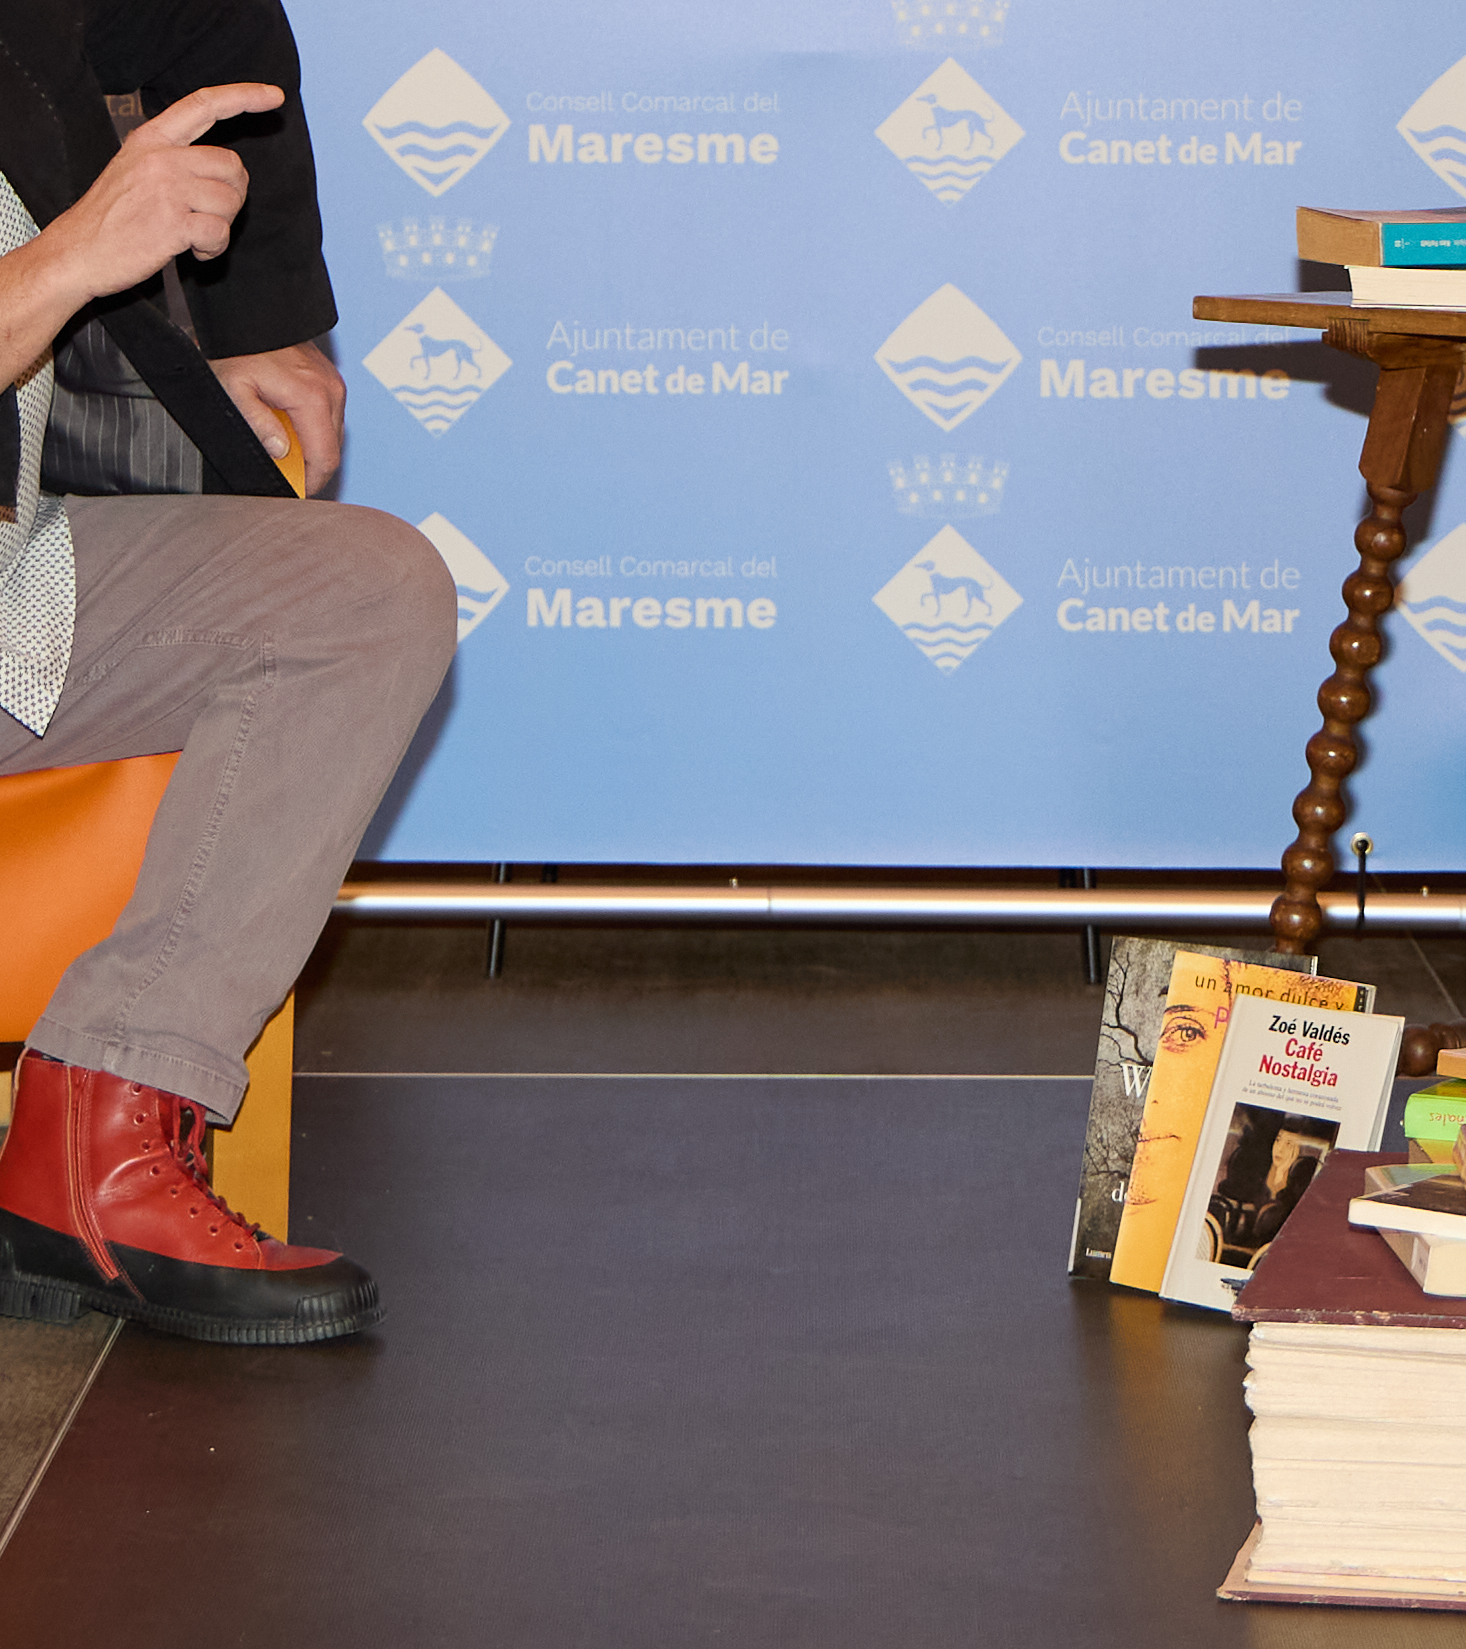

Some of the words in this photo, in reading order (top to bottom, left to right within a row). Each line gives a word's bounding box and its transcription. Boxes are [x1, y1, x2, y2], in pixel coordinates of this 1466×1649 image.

[1059, 90, 1254, 127] Ajuntament
[1262, 91, 1303, 122] de
[1059, 130, 1172, 165] Canet
[1178, 135, 1219, 165] de
[1225, 131, 1303, 165] Mar
[546, 320, 740, 357] Ajuntament
[748, 321, 790, 352] de
[546, 360, 659, 395] Canet
[665, 365, 706, 395] de
[712, 361, 790, 395] Mar
[524, 555, 613, 577] Consell
[619, 555, 734, 578] Comarcal
[740, 556, 778, 578] del
[1057, 558, 1251, 595] Ajuntament
[1259, 558, 1301, 590] de
[527, 588, 777, 629] Maresme
[1056, 597, 1170, 632] Canet
[1175, 603, 1216, 633] de
[1222, 599, 1301, 633] Mar
[1195, 974, 1216, 991] un
[1279, 989, 1327, 1009] dulce
[1268, 1015, 1297, 1035] Zoé
[1301, 1020, 1351, 1046] Valdés
[1284, 1037, 1324, 1063] Café
[1258, 1054, 1339, 1088] Nostalgia
